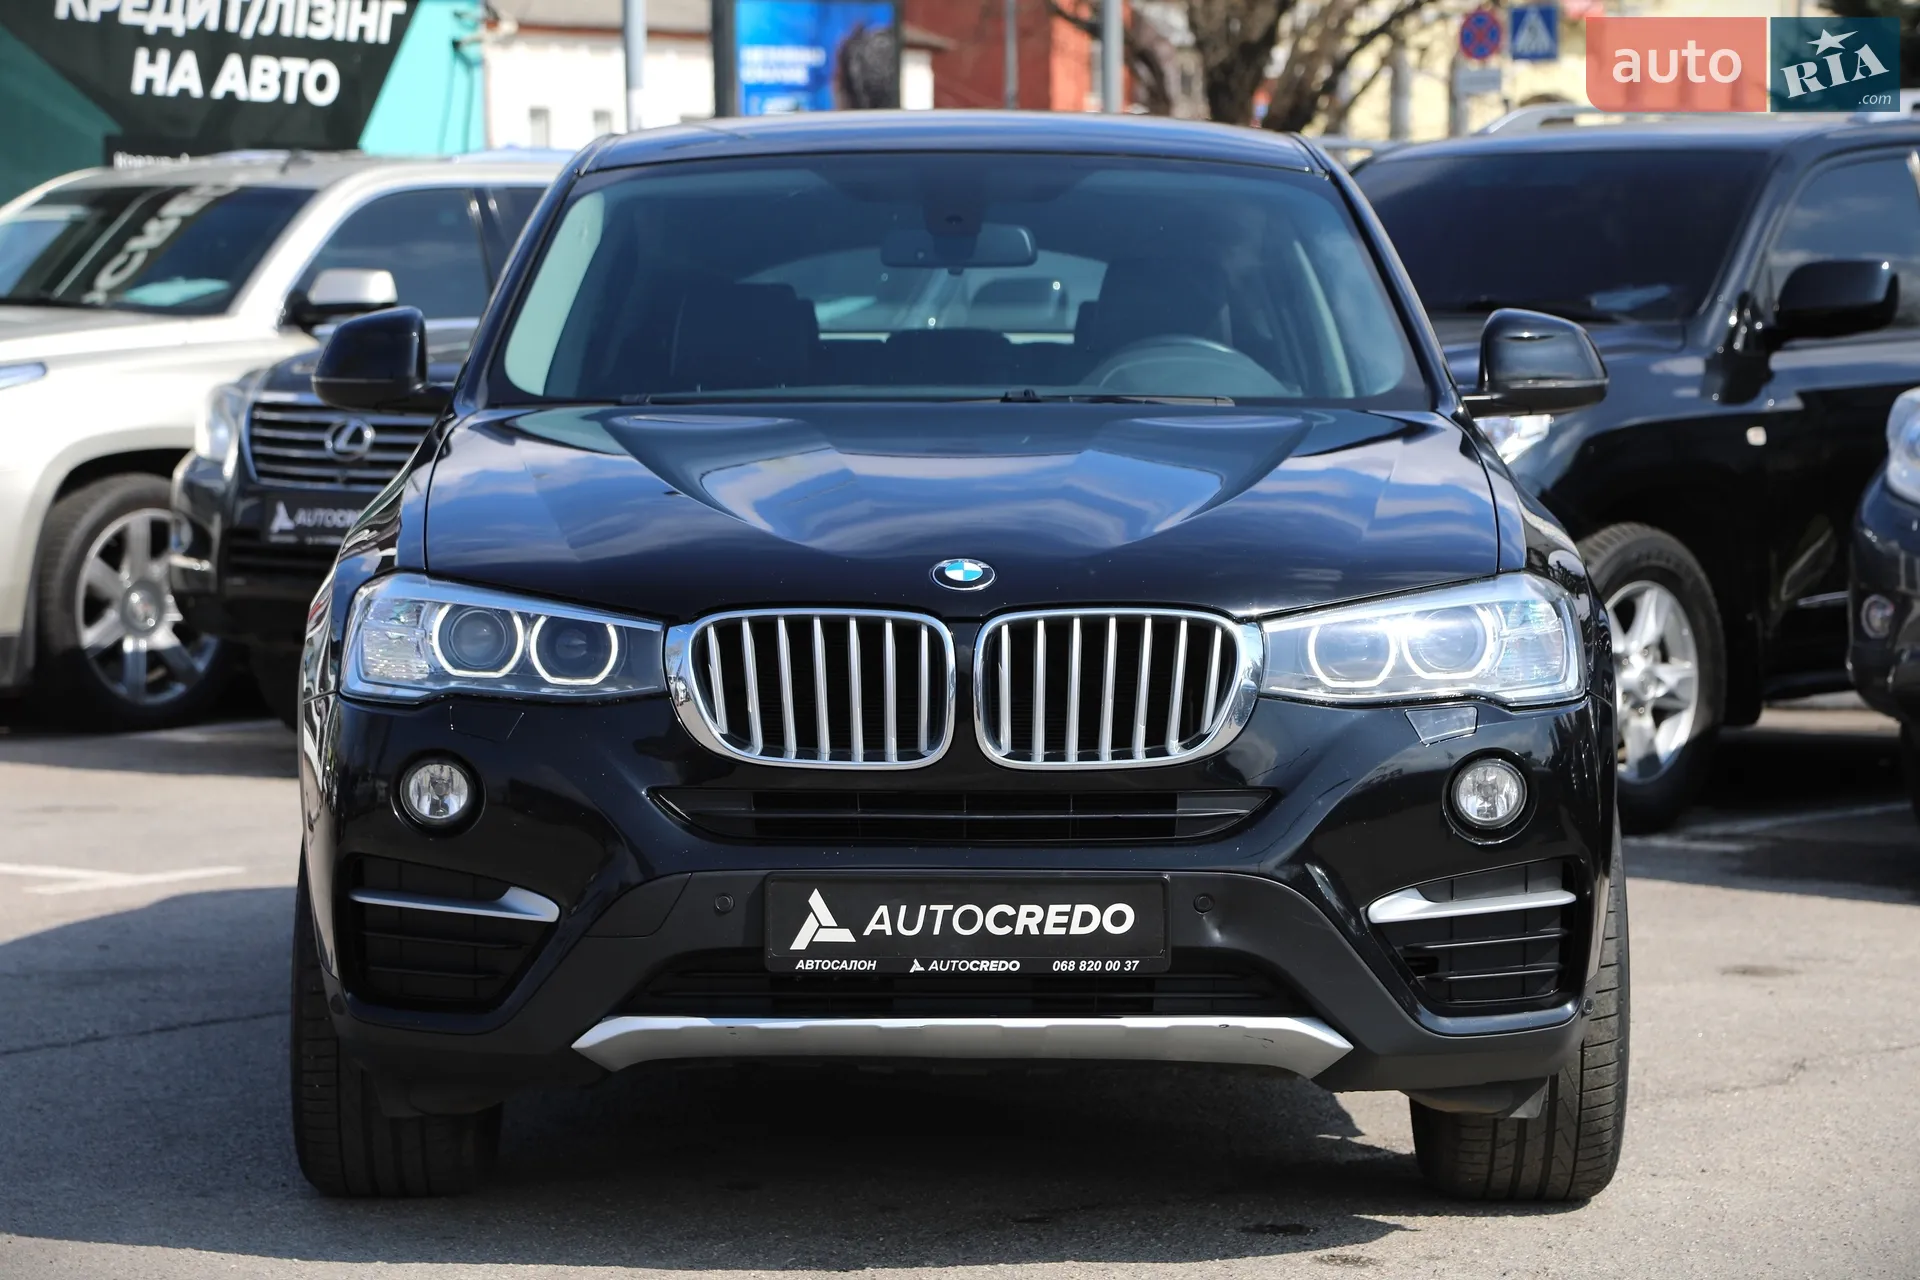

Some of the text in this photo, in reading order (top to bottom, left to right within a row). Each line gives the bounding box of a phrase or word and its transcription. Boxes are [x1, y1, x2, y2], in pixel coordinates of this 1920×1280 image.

[130, 46, 341, 107] НА АВТО
[862, 903, 1136, 936] AUTOCREDO
[795, 959, 877, 971] АВТОСАЛОН
[927, 959, 1021, 972] AUTOCREDO
[1052, 959, 1140, 972] 068 820 00 37
